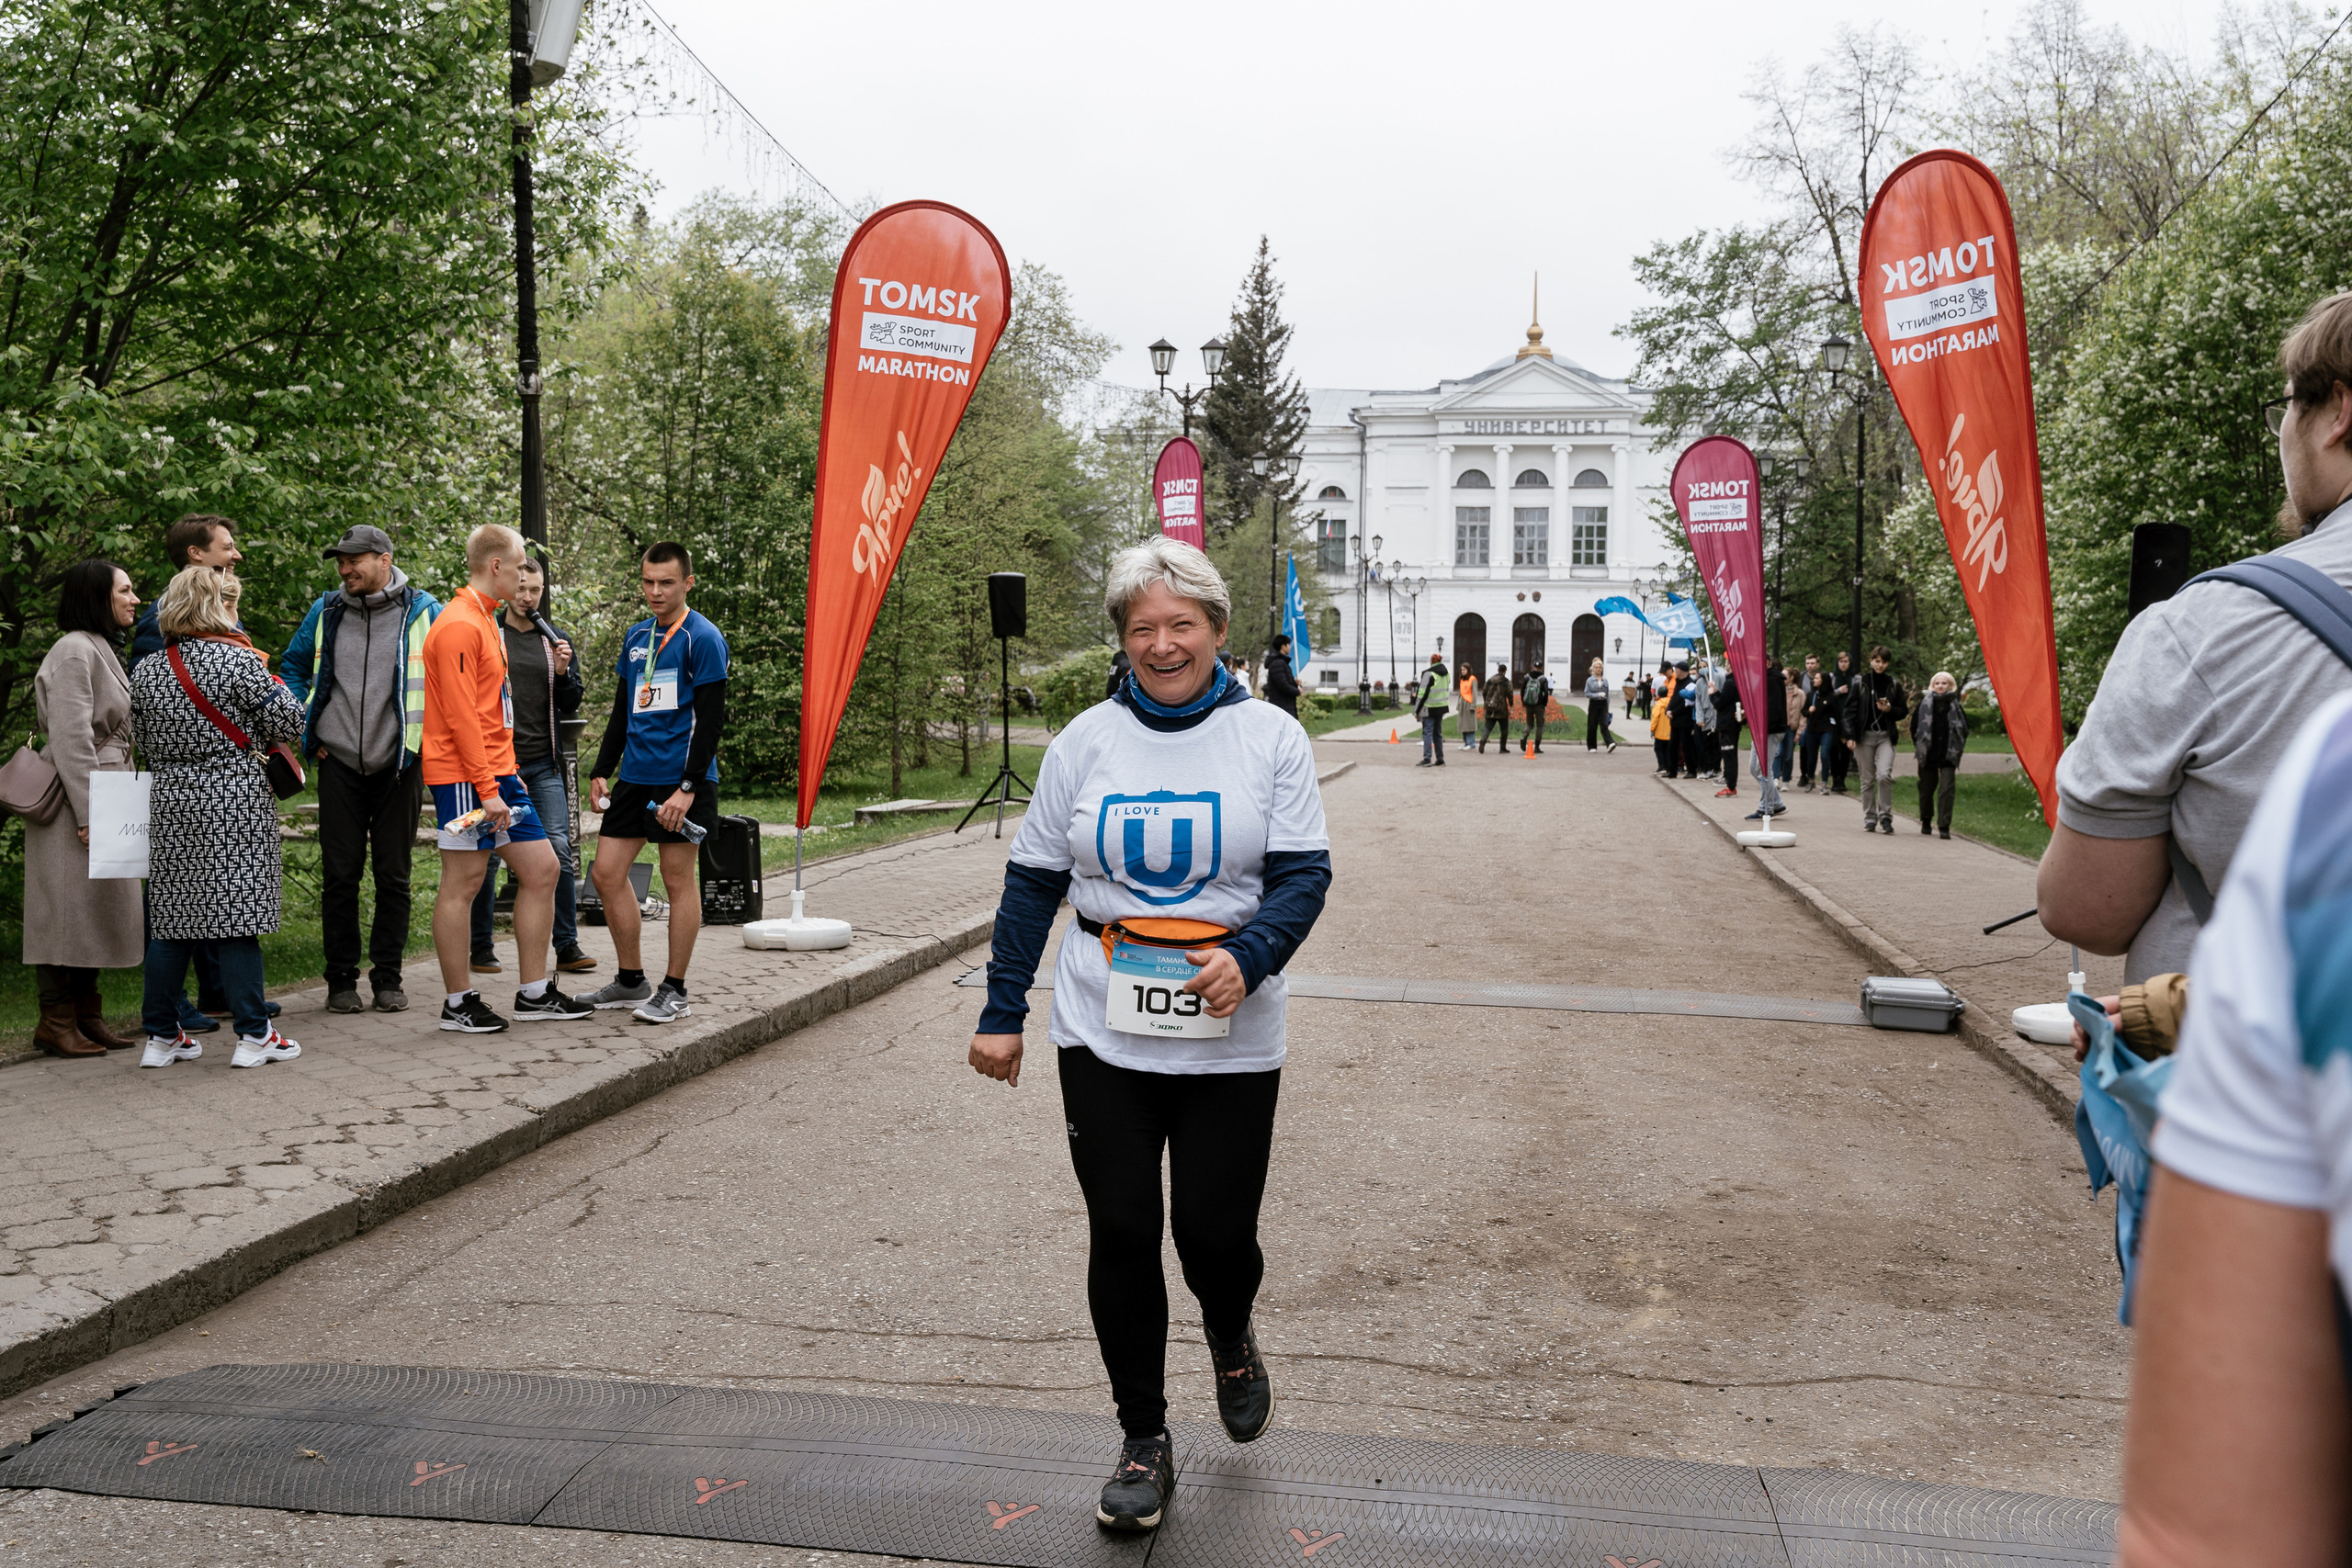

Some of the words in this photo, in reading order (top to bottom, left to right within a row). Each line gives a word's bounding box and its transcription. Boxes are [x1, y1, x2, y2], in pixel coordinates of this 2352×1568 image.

[859, 277, 980, 321] TOMSK
[899, 325, 936, 337] SPORT
[899, 337, 966, 355] COMMUNITY
[857, 355, 970, 386] MARATHON
[1464, 420, 1609, 434] УНИВЕРСИТЕТ
[1125, 807, 1160, 816] LOVE
[1123, 818, 1193, 887] U
[1162, 966, 1192, 975] СЕРДЦЕ
[1133, 985, 1202, 1017] 103
